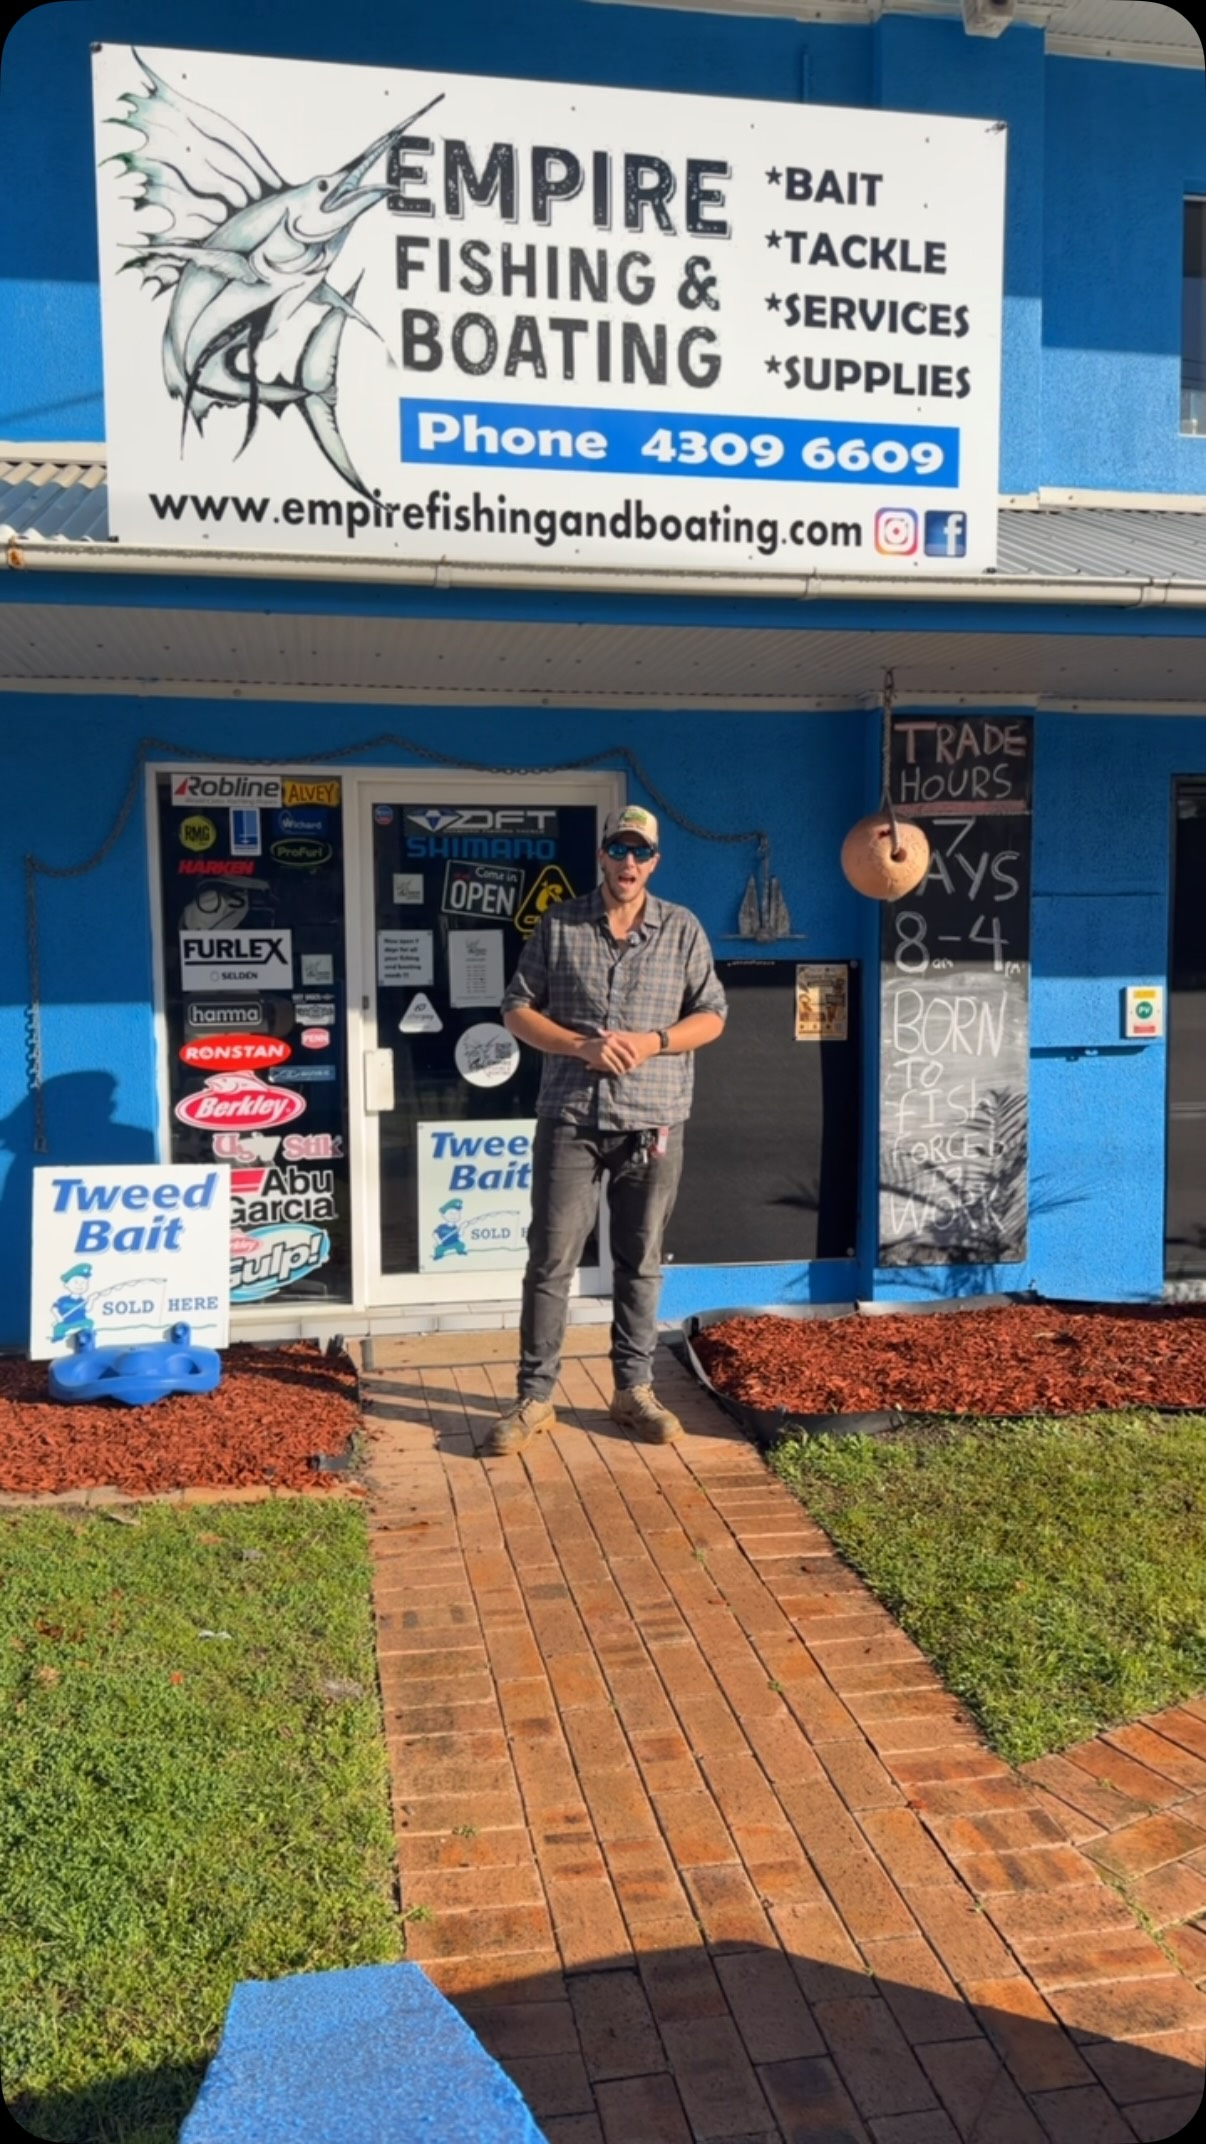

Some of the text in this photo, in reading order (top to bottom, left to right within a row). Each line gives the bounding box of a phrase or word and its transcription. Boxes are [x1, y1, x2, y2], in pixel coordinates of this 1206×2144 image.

[387, 135, 732, 240] EMPIRE
[396, 235, 720, 311] FISHING &
[402, 307, 722, 389] BOATING
[417, 412, 944, 474] Phone 4309 6609
[149, 490, 862, 555] www.empirefishingandboating.com
[894, 720, 1027, 764] TRADE
[175, 776, 280, 797] Robline
[289, 783, 335, 802] ALVEY
[901, 763, 1012, 802] HOURS
[185, 825, 211, 841] RMG
[281, 817, 322, 831] Wichard
[446, 809, 556, 829] DFT
[407, 837, 556, 860] SHIMANO
[933, 817, 976, 857] 7
[178, 860, 255, 874] HARKEN
[506, 870, 518, 882] in
[917, 849, 1020, 902] AYS
[451, 879, 515, 916] OPEN
[183, 937, 288, 965] FURLEX
[191, 1005, 258, 1023] hamma
[893, 987, 1008, 1058] BORN
[186, 1043, 285, 1061] RONSTAN
[893, 1056, 944, 1089] TO
[195, 1096, 288, 1123] Berkley
[431, 1131, 530, 1159] Twee
[261, 1166, 334, 1196] Abu
[449, 1160, 532, 1191] Bait
[51, 1172, 218, 1213] Tweed
[74, 1215, 184, 1254] Bait
[471, 1228, 511, 1240] SOLD
[102, 1297, 219, 1315] SOLD HERE
